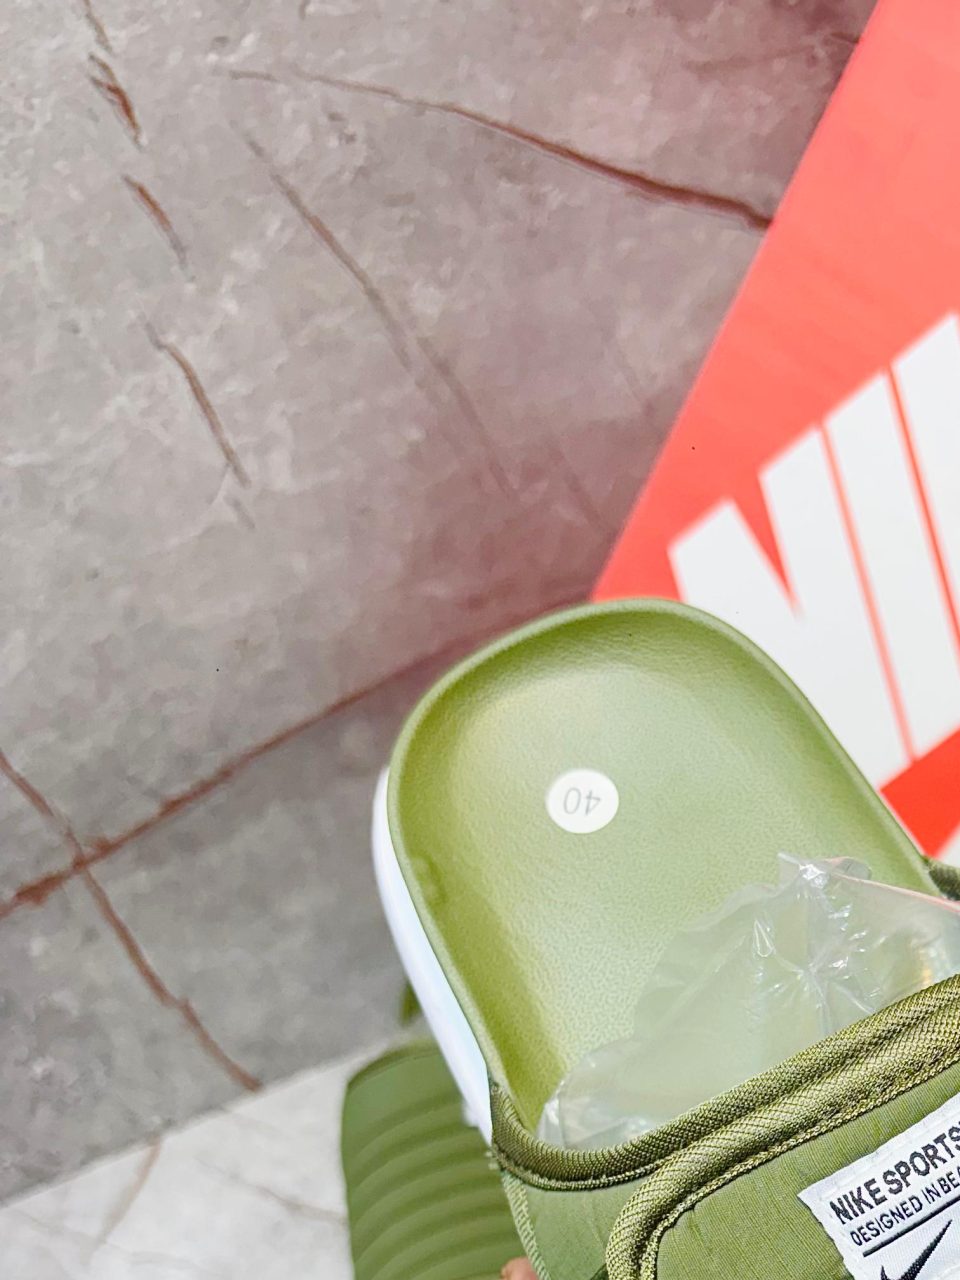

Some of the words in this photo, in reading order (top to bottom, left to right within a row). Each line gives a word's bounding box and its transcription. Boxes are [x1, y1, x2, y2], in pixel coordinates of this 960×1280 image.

[563, 787, 602, 816] 40
[829, 1178, 888, 1225] NIKE
[850, 1195, 923, 1247] DESIGNED
[921, 1183, 942, 1204] IN
